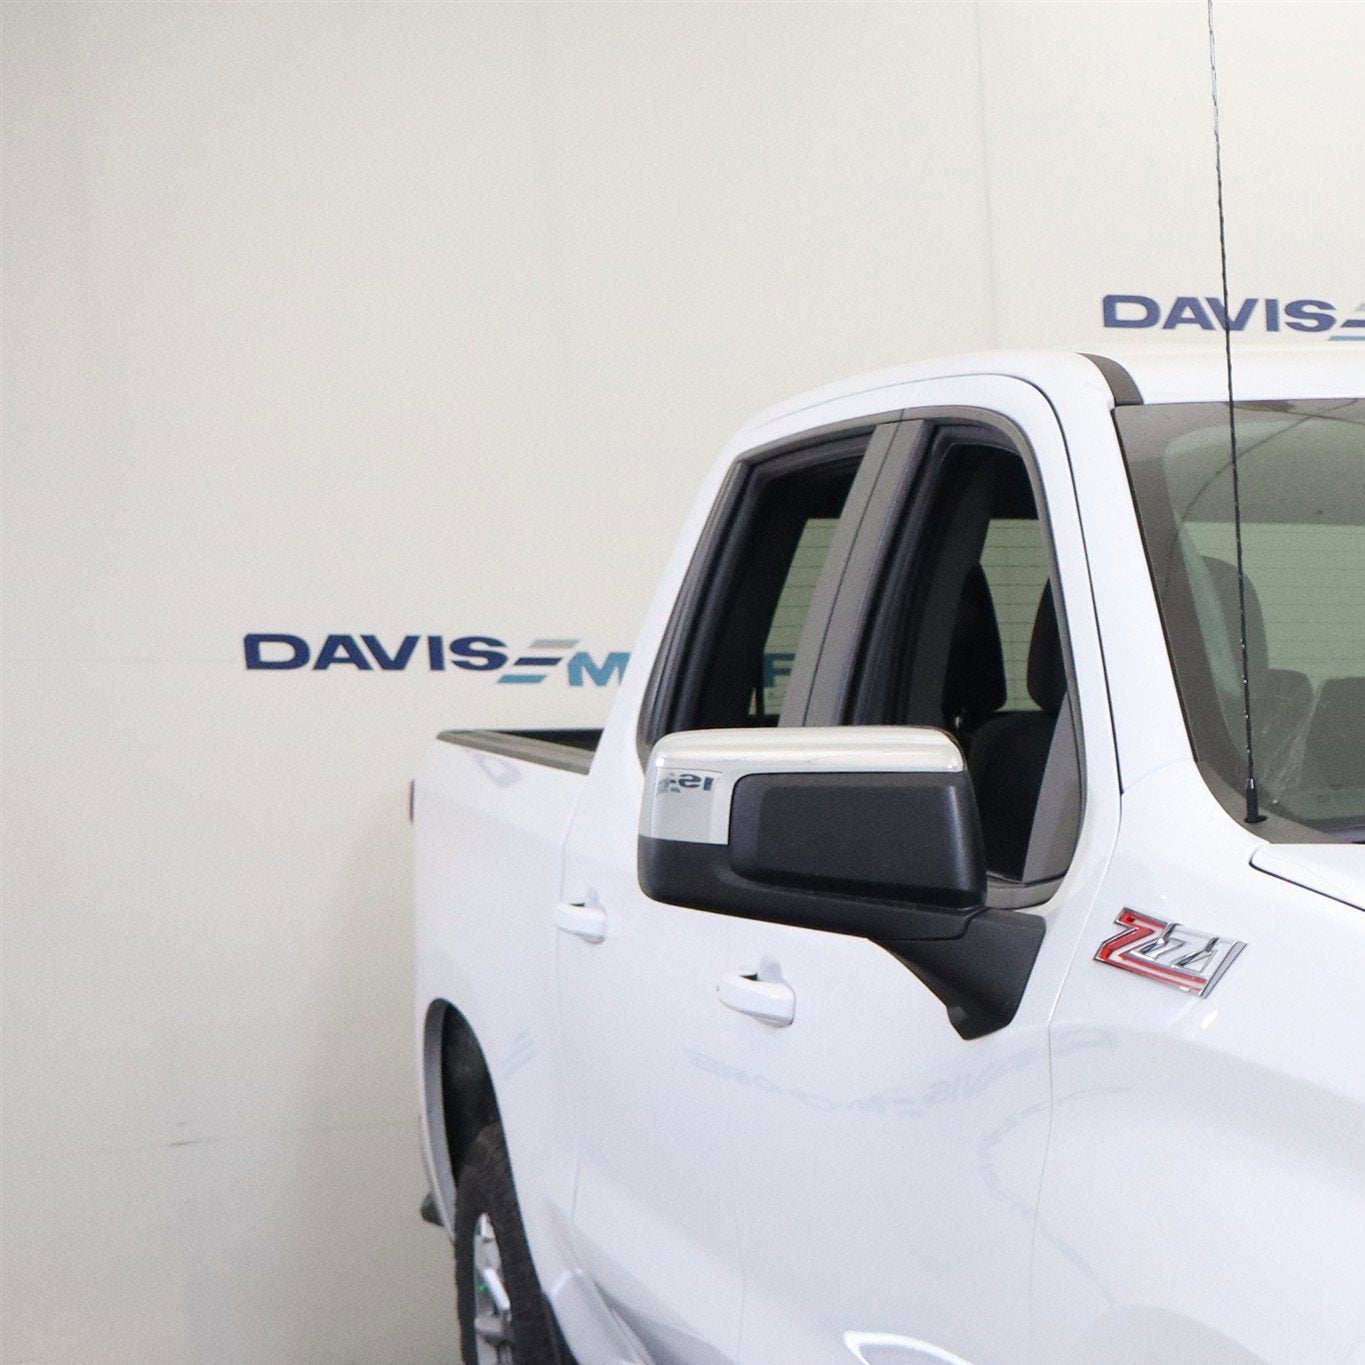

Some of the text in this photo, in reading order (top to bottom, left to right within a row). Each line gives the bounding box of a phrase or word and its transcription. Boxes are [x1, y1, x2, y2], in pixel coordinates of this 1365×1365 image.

[1102, 293, 1338, 333] DAVIS
[242, 632, 510, 673] DAVIS
[1092, 906, 1249, 999] Z71
